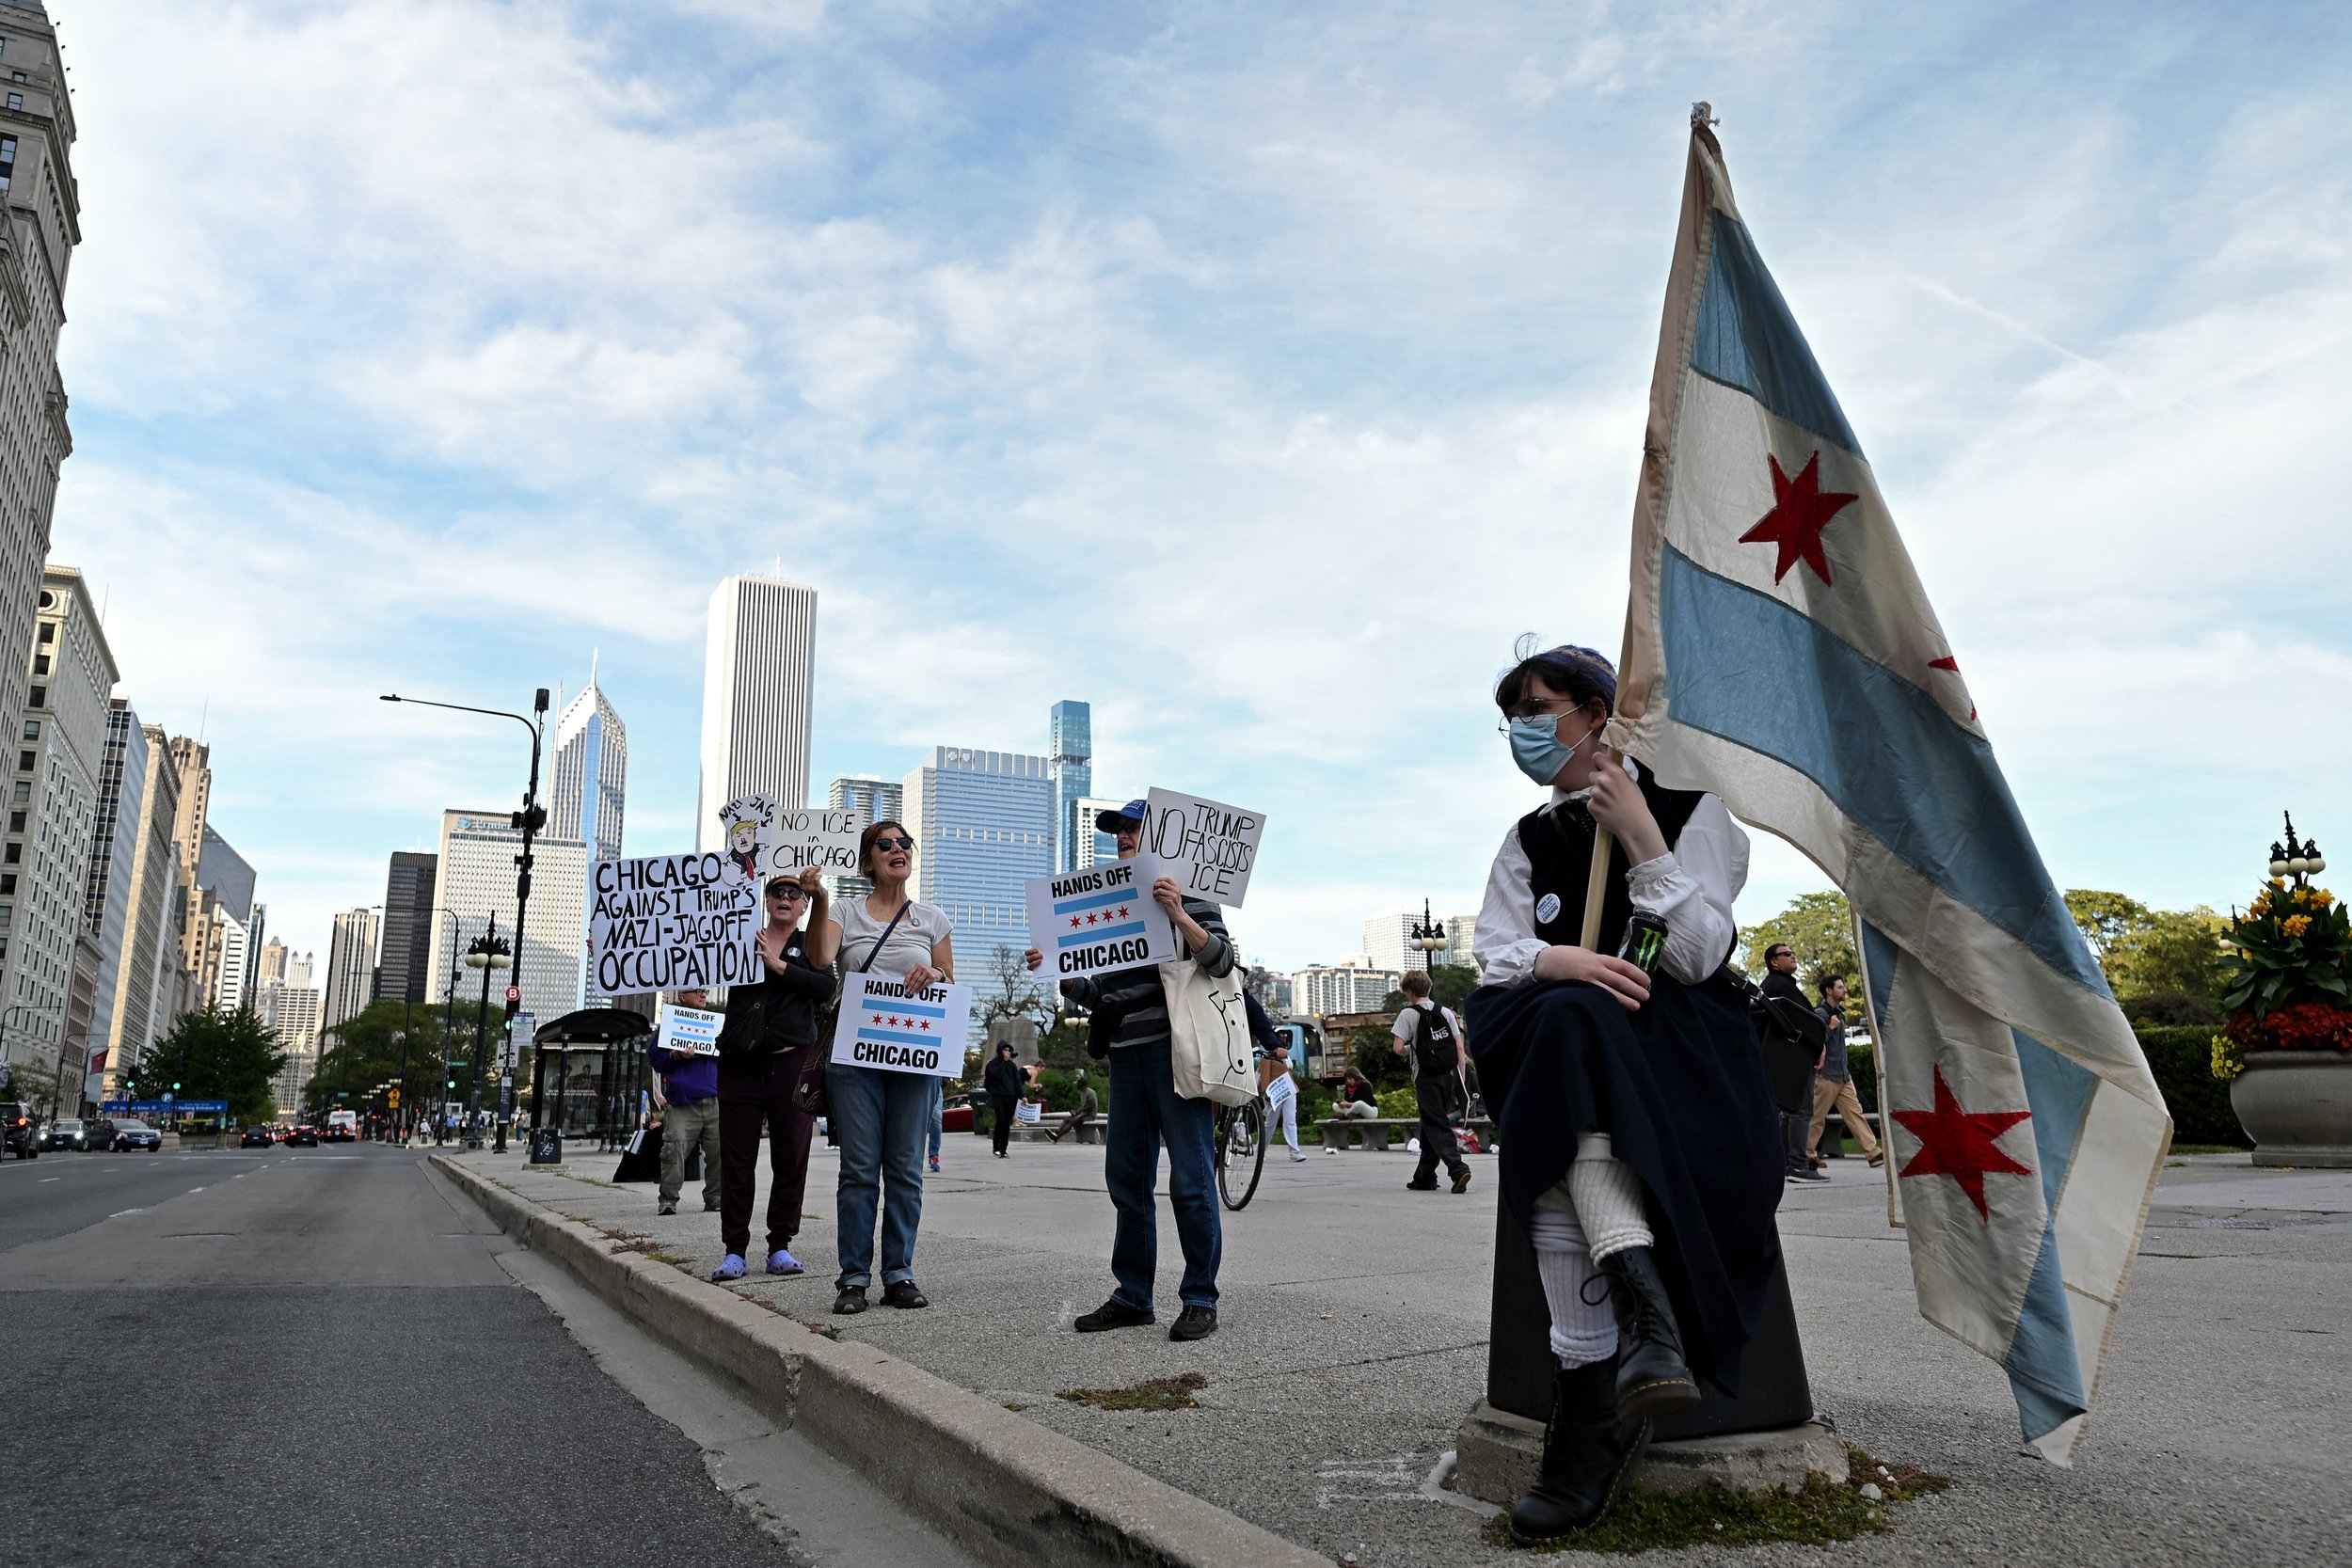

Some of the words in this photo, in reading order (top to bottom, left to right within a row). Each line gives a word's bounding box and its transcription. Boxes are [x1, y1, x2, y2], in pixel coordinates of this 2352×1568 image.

[719, 800, 743, 821] NAZI
[782, 813, 809, 832] NO
[823, 813, 855, 833] ICE
[1194, 803, 1256, 839] TRUMP
[1137, 803, 1186, 859] NO
[773, 845, 856, 869] CHICAGO
[1182, 829, 1252, 873] FASCISTS
[596, 852, 722, 894] CHICAGO
[1051, 872, 1103, 898] HANDS
[1106, 865, 1133, 886] OFF
[1189, 863, 1235, 895] ICE
[591, 888, 685, 921] AGAINST
[1543, 905, 1558, 922] CHICAGO
[603, 910, 752, 950] NAZI-JAGOFF
[599, 942, 758, 991] OCCUPATION
[1058, 938, 1149, 974] CHICAGO
[509, 989, 517, 997] B
[919, 987, 947, 1003] OFF
[674, 1009, 700, 1020] HANDS
[701, 1013, 715, 1022] OFF
[671, 1037, 712, 1052] CHICAGO
[853, 1041, 939, 1069] CHICAGO
[163, 1093, 171, 1101] P
